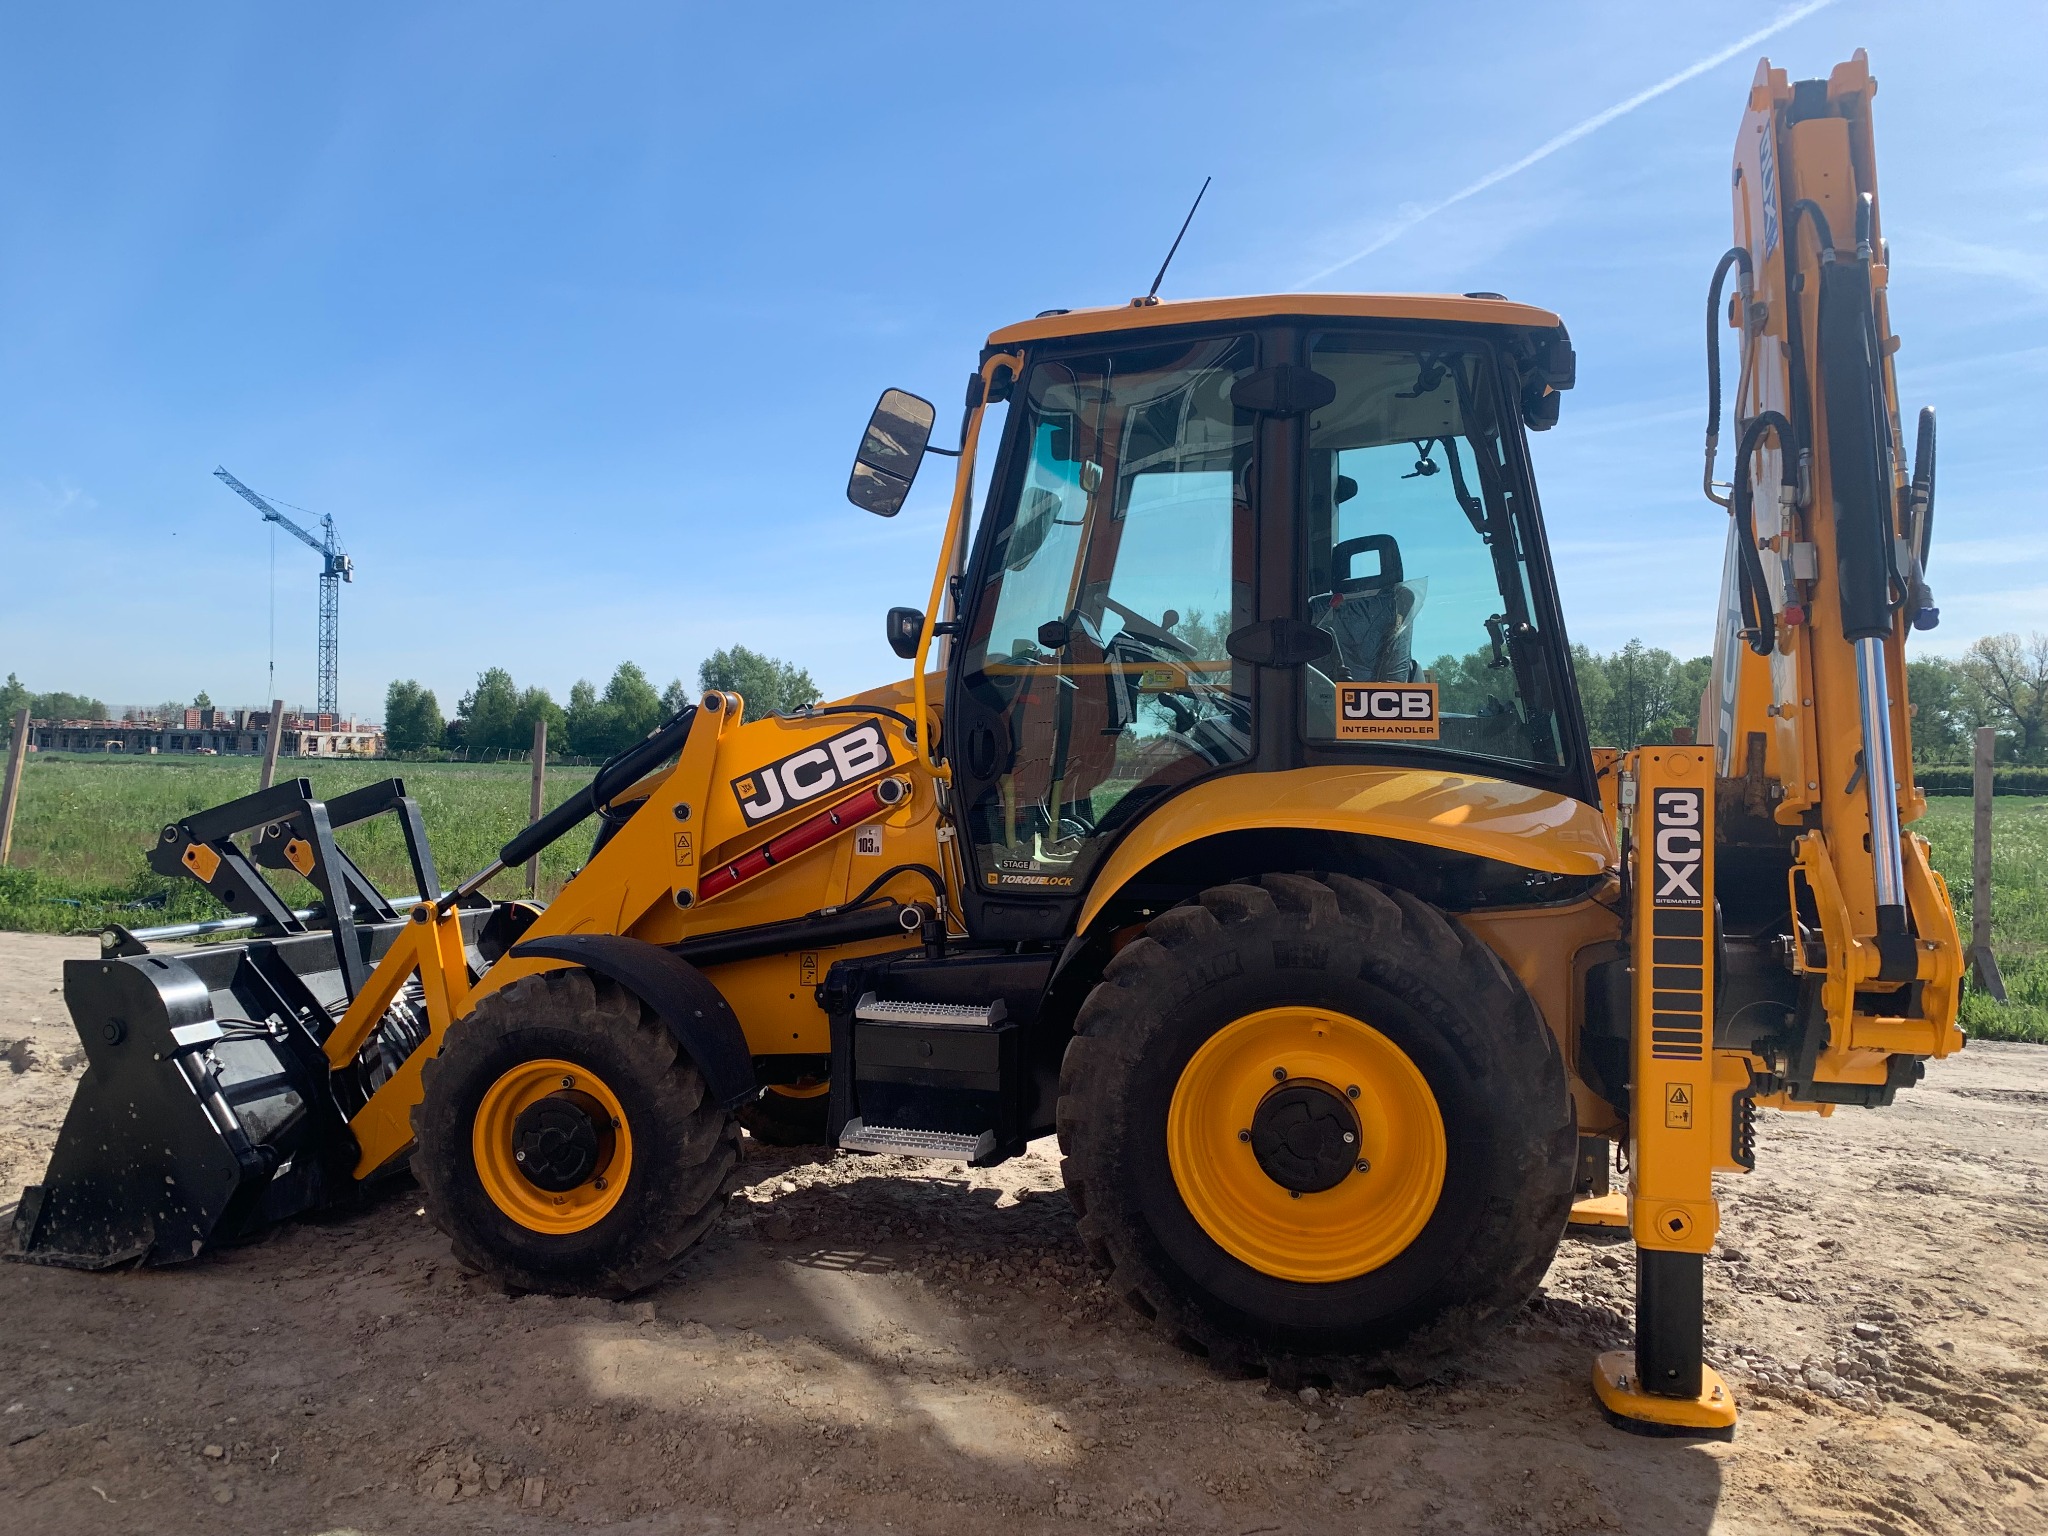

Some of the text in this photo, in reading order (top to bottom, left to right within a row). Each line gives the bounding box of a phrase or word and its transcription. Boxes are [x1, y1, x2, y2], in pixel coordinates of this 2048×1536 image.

[1345, 692, 1430, 717] JCB
[744, 726, 887, 819] JCB
[858, 837, 873, 852] 103
[1656, 792, 1701, 896] 3CX
[1003, 860, 1028, 868] STAGE
[1002, 875, 1074, 886] TORQUELOCK
